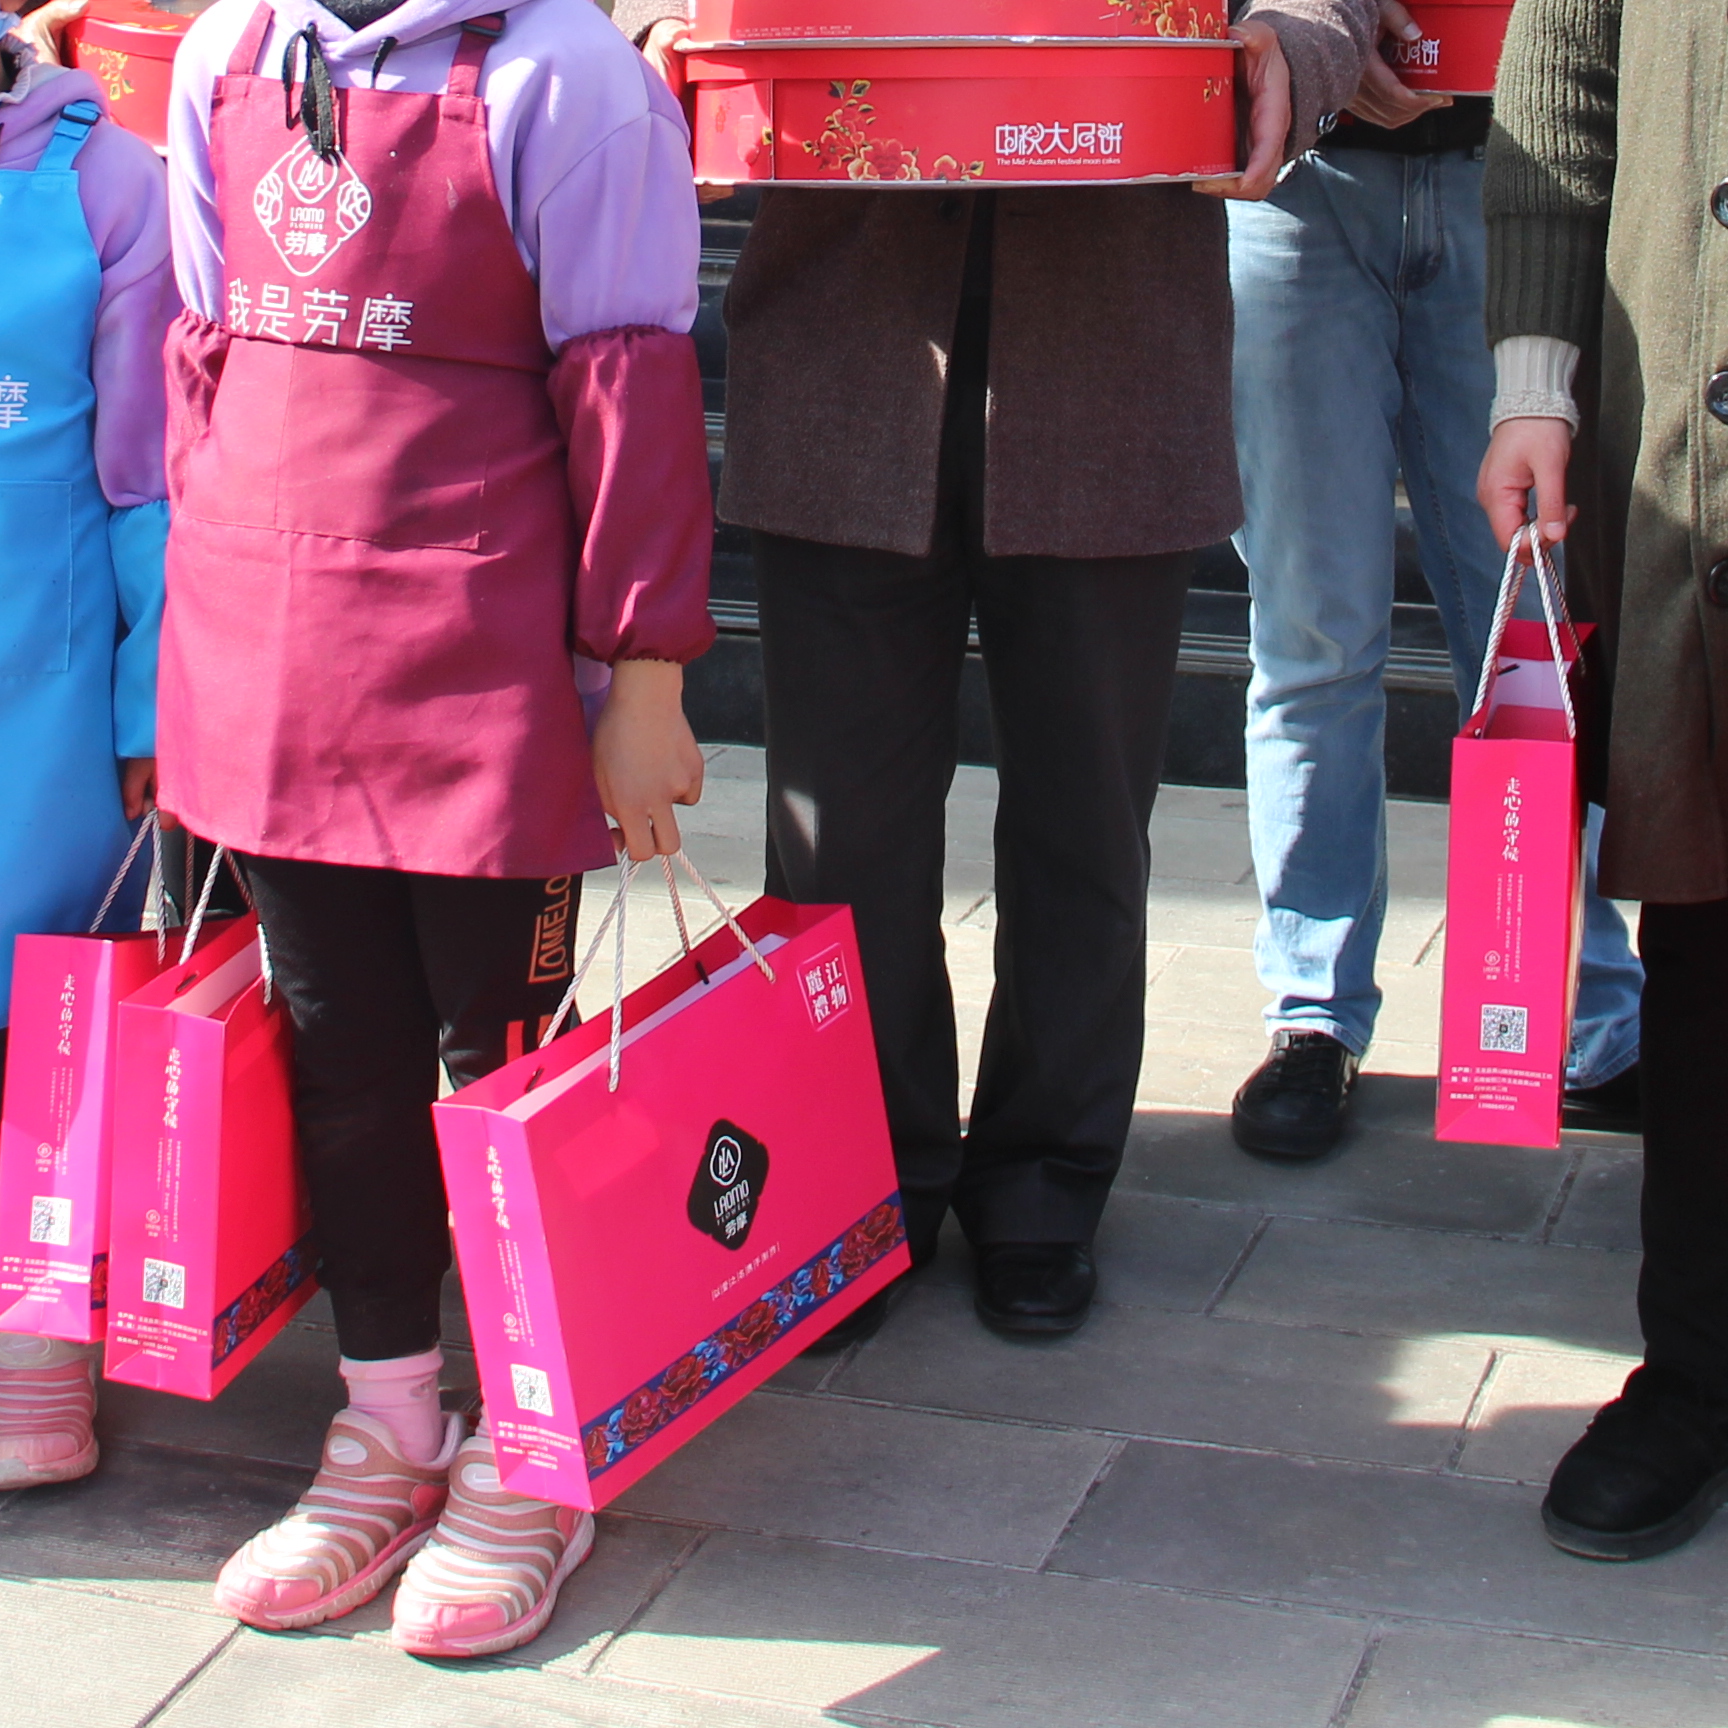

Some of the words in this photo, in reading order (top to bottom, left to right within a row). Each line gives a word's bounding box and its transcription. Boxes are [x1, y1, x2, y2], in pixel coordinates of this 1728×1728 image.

[995, 121, 1123, 156] 中秋大月饼
[290, 206, 325, 222] LAOMO
[290, 222, 324, 230] FLOWERS
[284, 230, 328, 257] 劳摩
[228, 277, 414, 352] 我是劳摩
[1502, 777, 1522, 862] 走心的守候
[713, 1179, 750, 1218] LAOMO
[725, 1211, 748, 1239] 劳摩
